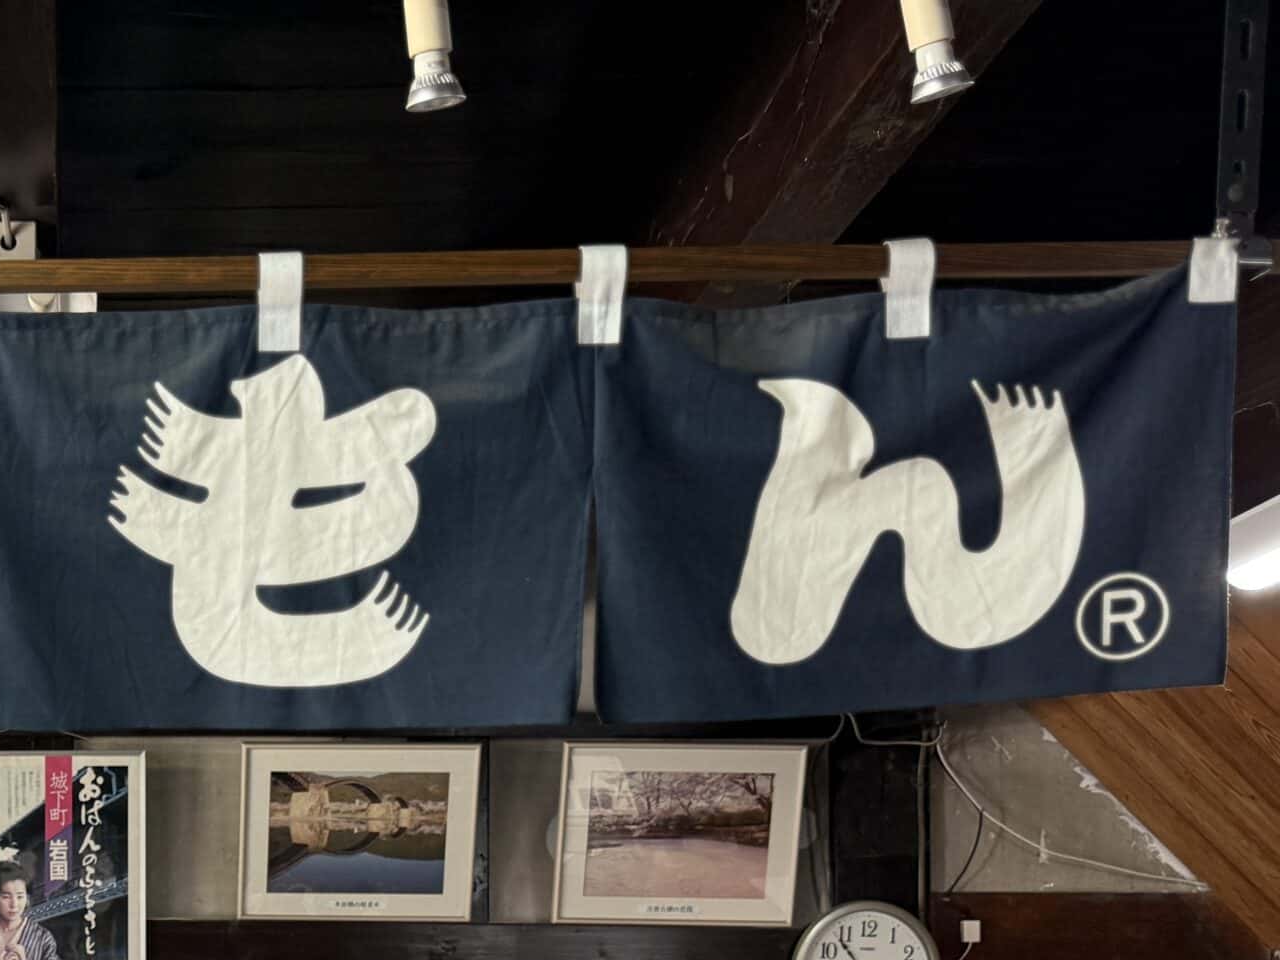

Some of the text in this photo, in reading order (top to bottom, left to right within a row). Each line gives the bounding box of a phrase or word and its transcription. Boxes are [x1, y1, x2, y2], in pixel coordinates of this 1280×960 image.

[50, 770, 68, 827] 城下町
[49, 839, 68, 881] 岩国
[839, 925, 852, 942] 11
[861, 920, 878, 937] 12
[890, 927, 896, 944] 1
[821, 942, 837, 959] 10
